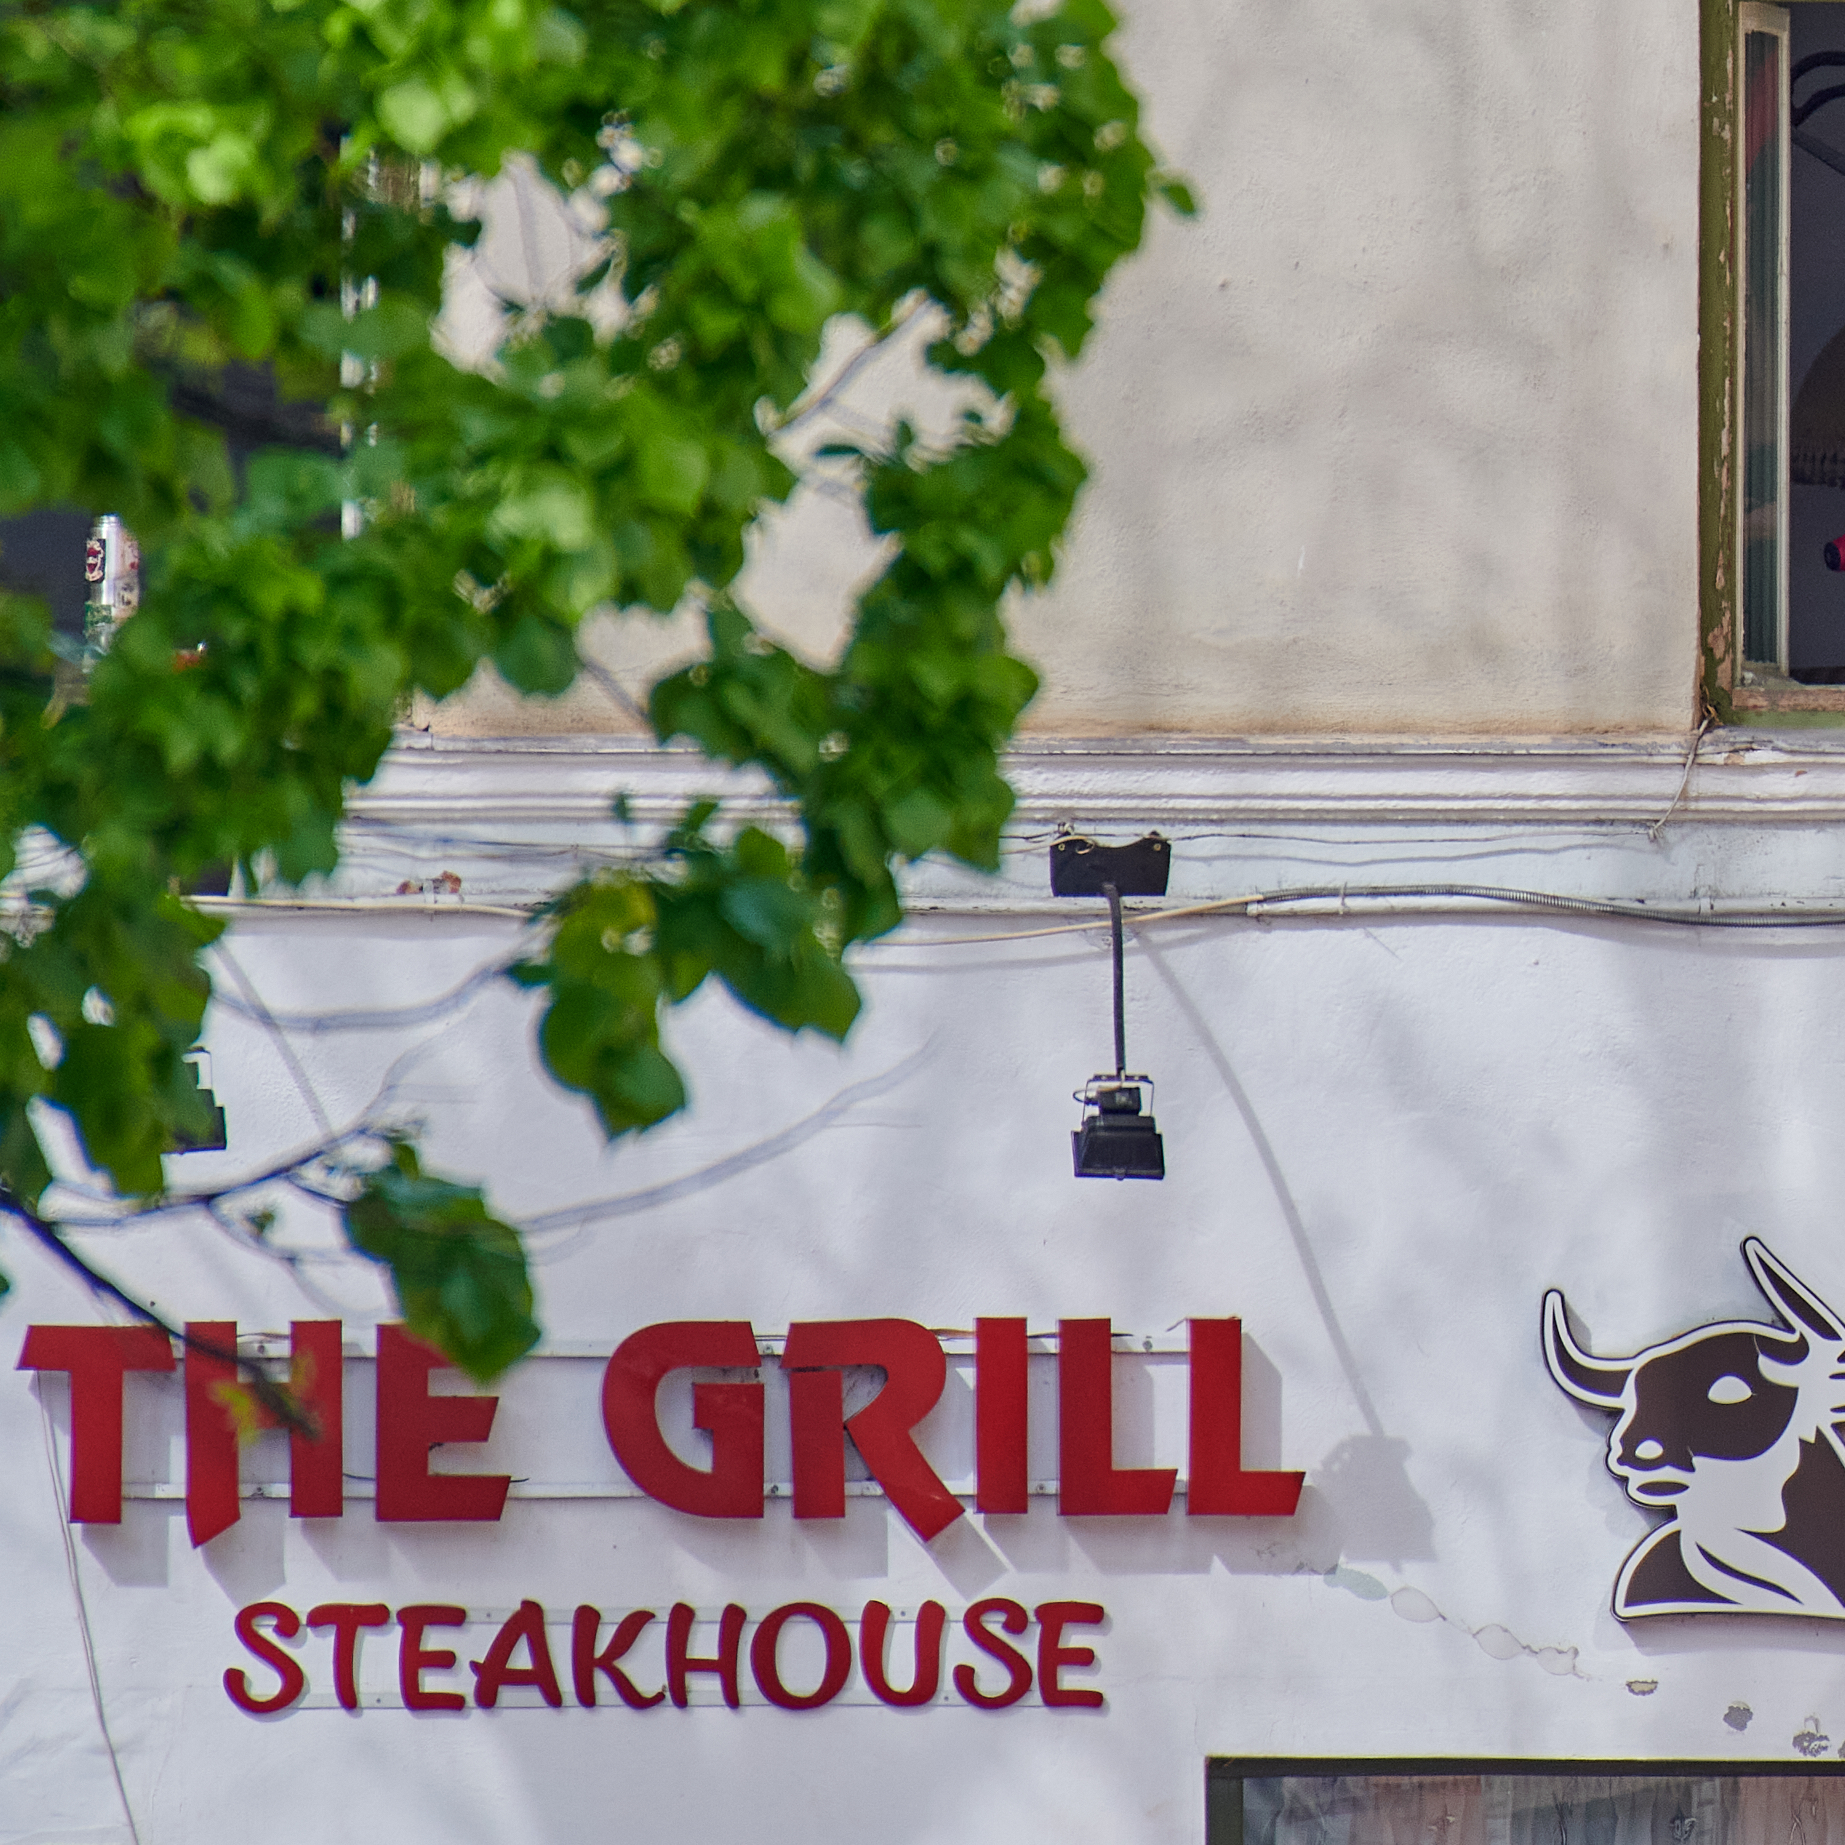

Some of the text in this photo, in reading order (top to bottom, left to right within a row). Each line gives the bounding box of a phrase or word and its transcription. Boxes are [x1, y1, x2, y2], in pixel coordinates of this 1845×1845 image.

[16, 1316, 1307, 1549] THE GRILL
[222, 1599, 1107, 1715] STEAKHOUSE
